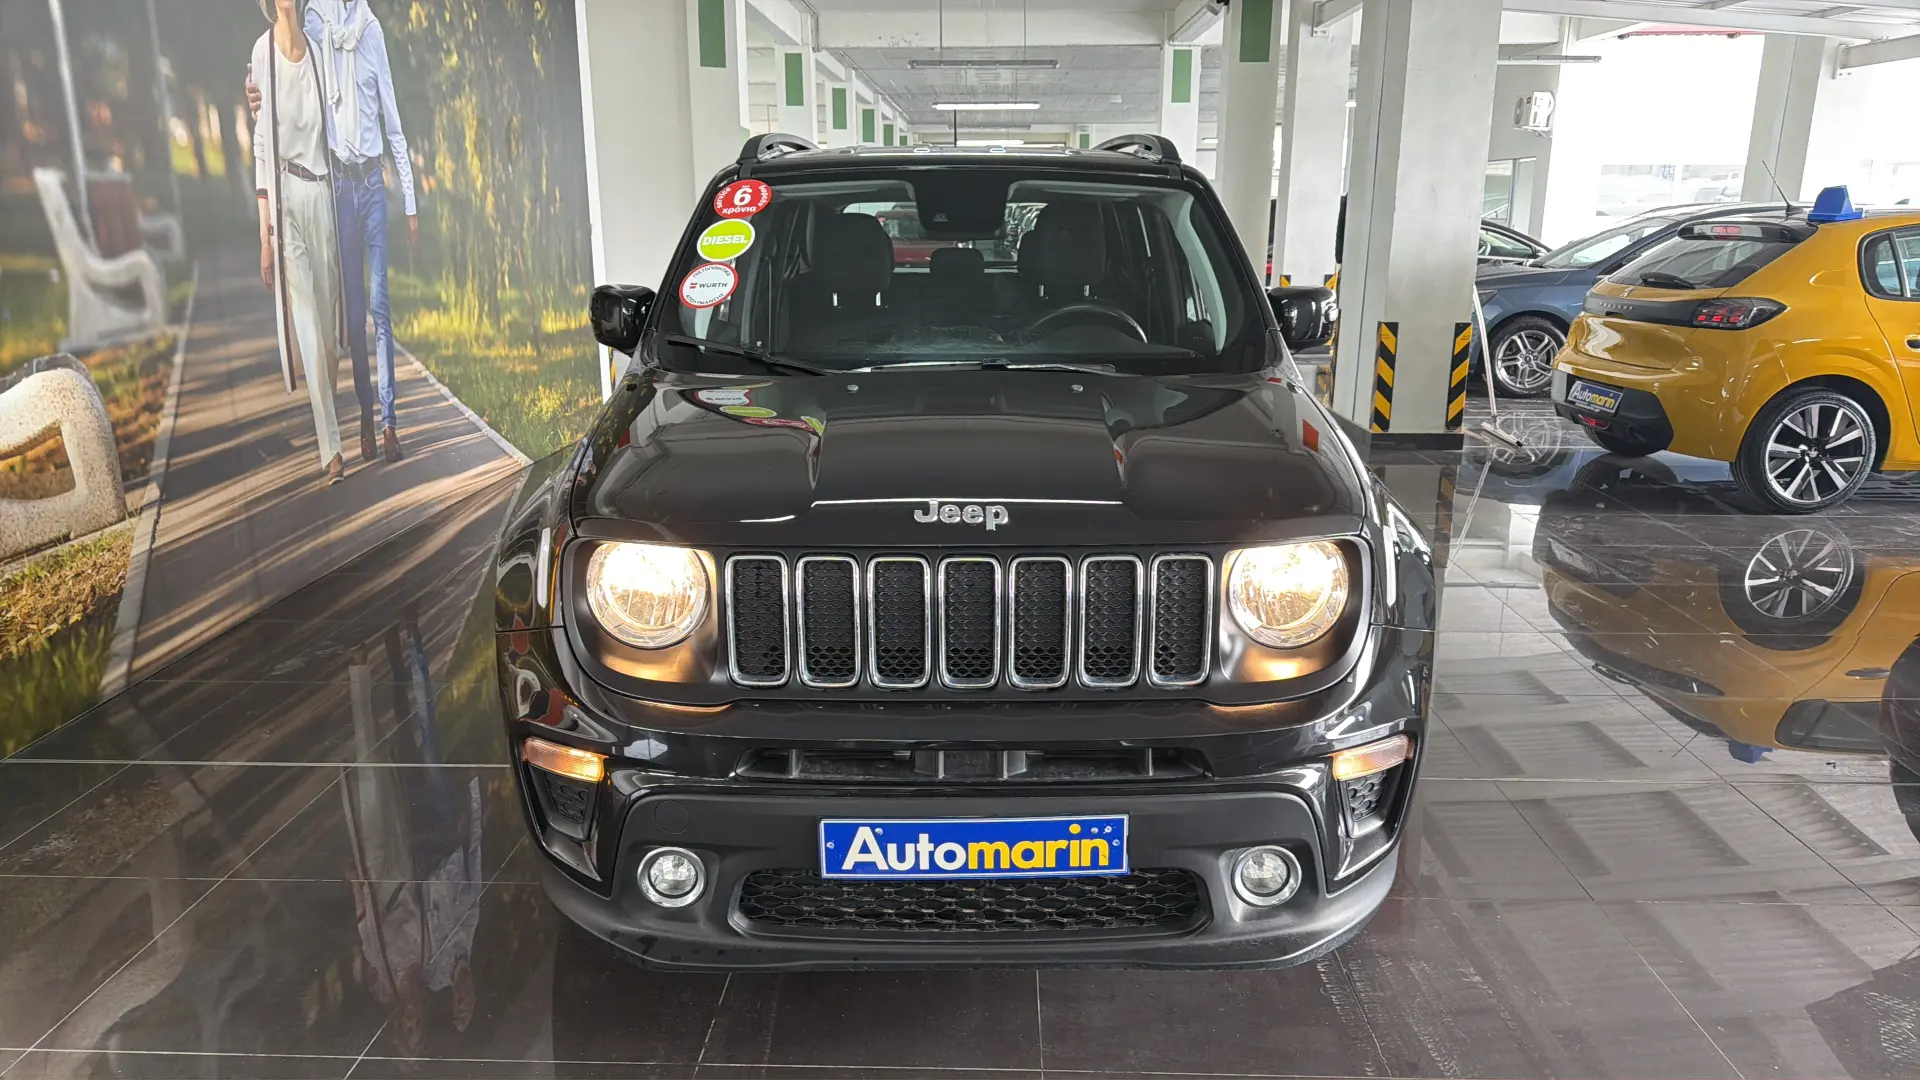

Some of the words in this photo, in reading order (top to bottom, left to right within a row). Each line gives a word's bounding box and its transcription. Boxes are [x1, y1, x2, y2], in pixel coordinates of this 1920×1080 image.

[733, 187, 753, 206] 6
[722, 206, 756, 214] χρόνια
[703, 235, 748, 245] DIESEL
[1571, 384, 1616, 409] Automarin
[914, 500, 1009, 531] Jeep
[841, 823, 1109, 870] Automarin
